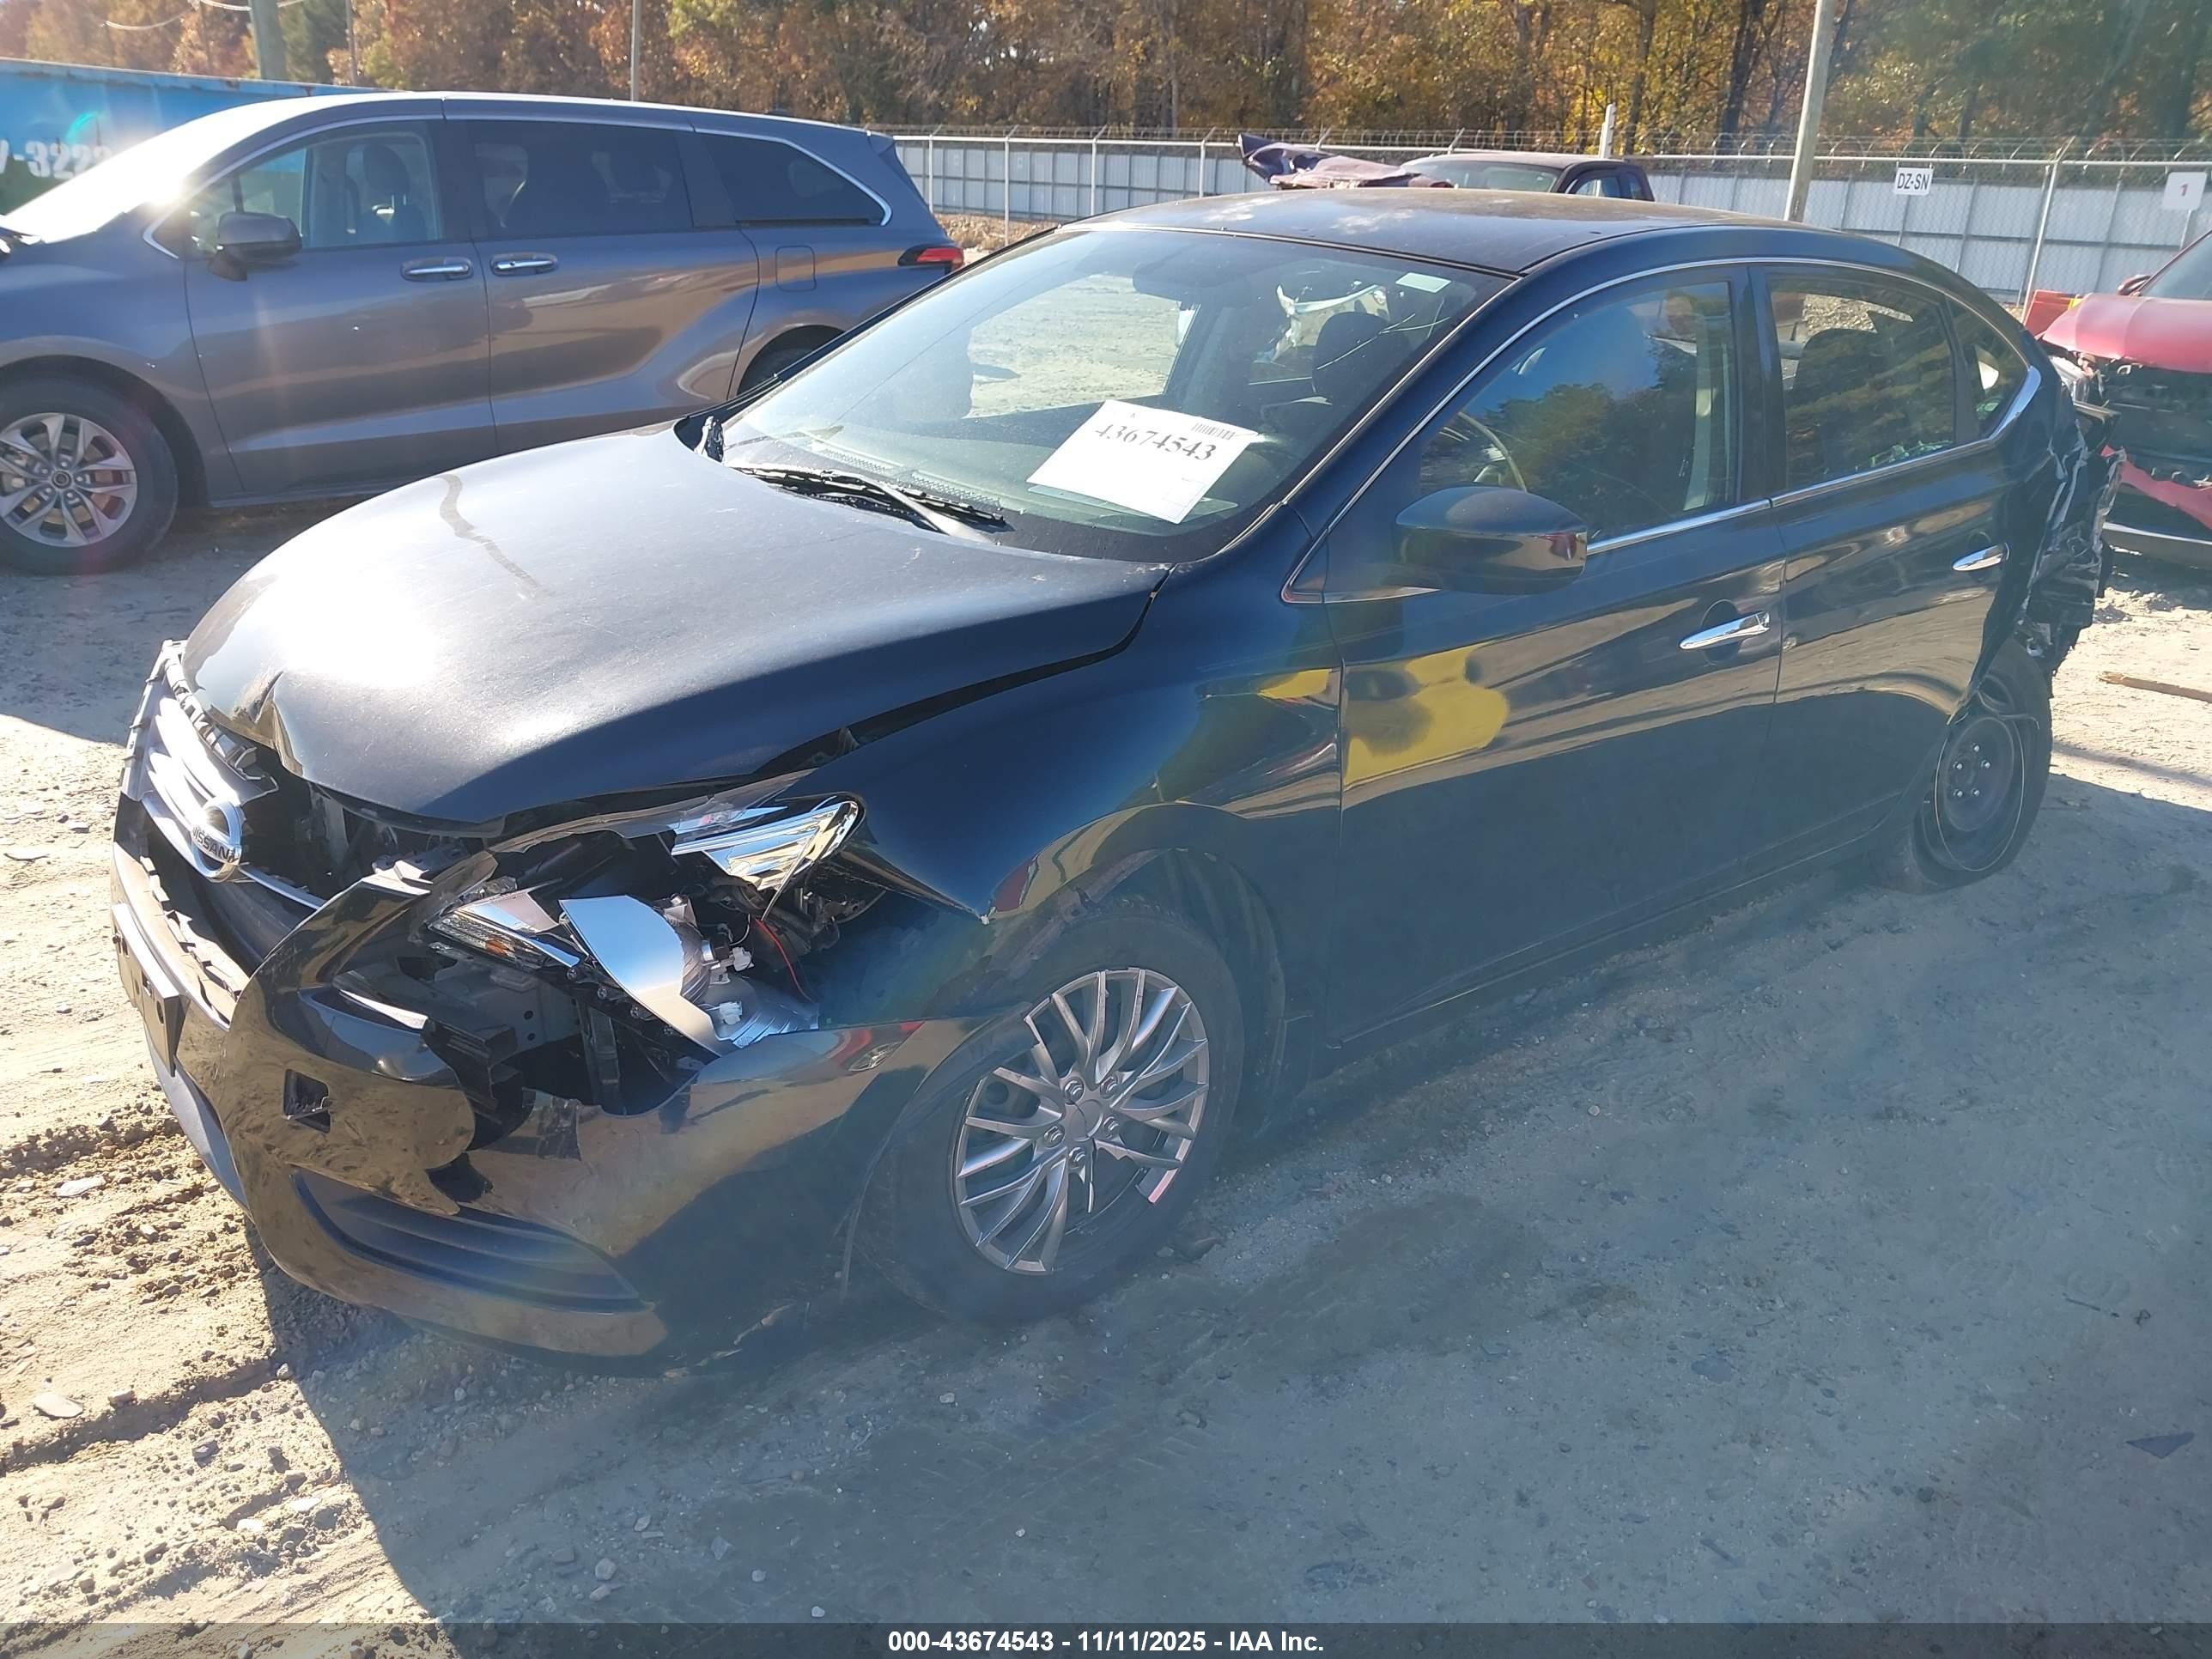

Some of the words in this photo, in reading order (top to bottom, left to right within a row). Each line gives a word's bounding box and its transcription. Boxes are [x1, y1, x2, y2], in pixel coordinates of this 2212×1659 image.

[1897, 173, 1930, 190] DZ-SN
[2180, 184, 2189, 197] 1
[1095, 423, 1217, 461] 43674543
[191, 824, 232, 862] NISSAN
